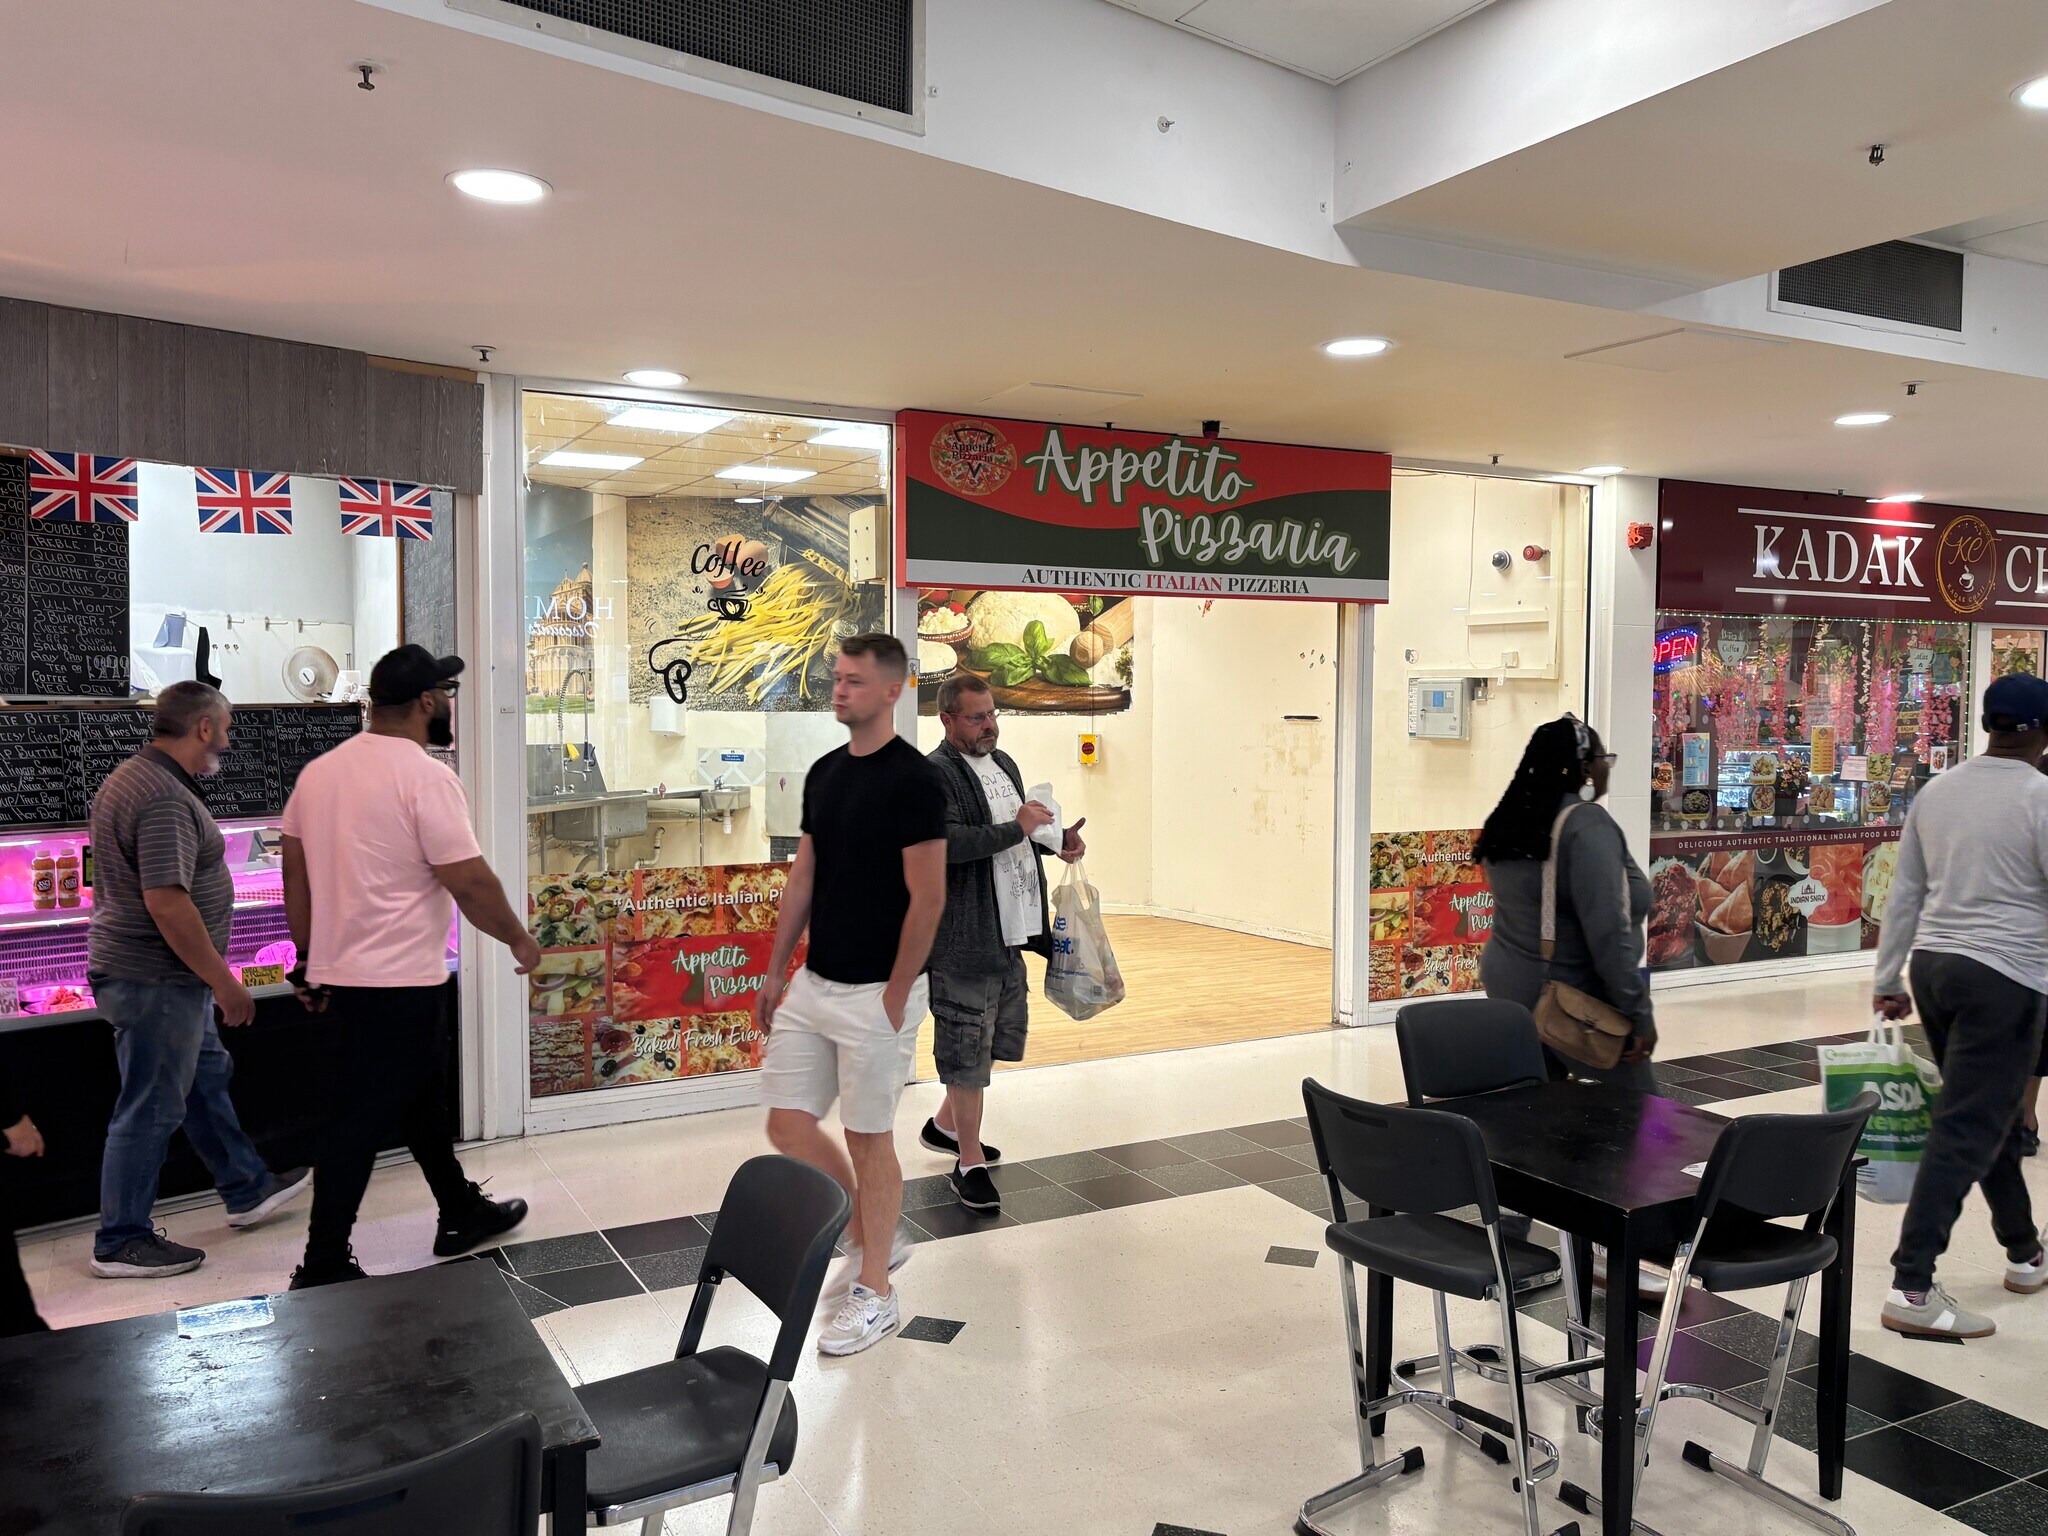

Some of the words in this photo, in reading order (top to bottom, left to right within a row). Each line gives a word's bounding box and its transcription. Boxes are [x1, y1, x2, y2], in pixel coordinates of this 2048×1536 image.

[951, 442, 996, 453] Appetito
[1025, 429, 1252, 502] Appetito
[1142, 507, 1356, 572] Pizzaria
[691, 541, 767, 579] Coffee
[1753, 524, 1924, 587] KADAK
[30, 579, 60, 594] ADD
[1021, 568, 1141, 589] AUTHENTIC
[1146, 574, 1222, 591] ITALIAN
[1227, 578, 1310, 594] PIZZERIA
[31, 594, 72, 611] FULL
[73, 598, 126, 618] MONTY
[46, 663, 68, 672] TEA
[1678, 839, 1723, 849] DELICIOUS
[1726, 836, 1771, 846] AUTHENTIC
[1775, 833, 1828, 844] TRADITIONAL
[1830, 832, 1858, 841] INDIAN
[1860, 831, 1881, 839] FOOD
[712, 889, 763, 907] Italian
[1449, 891, 1494, 914] Appetito
[1790, 896, 1810, 904] INDIAN
[672, 945, 750, 974] Appetito
[1424, 954, 1453, 974] Baked
[1453, 954, 1478, 971] Fresh
[631, 1027, 678, 1056] Baked
[682, 1026, 724, 1049] Fresh
